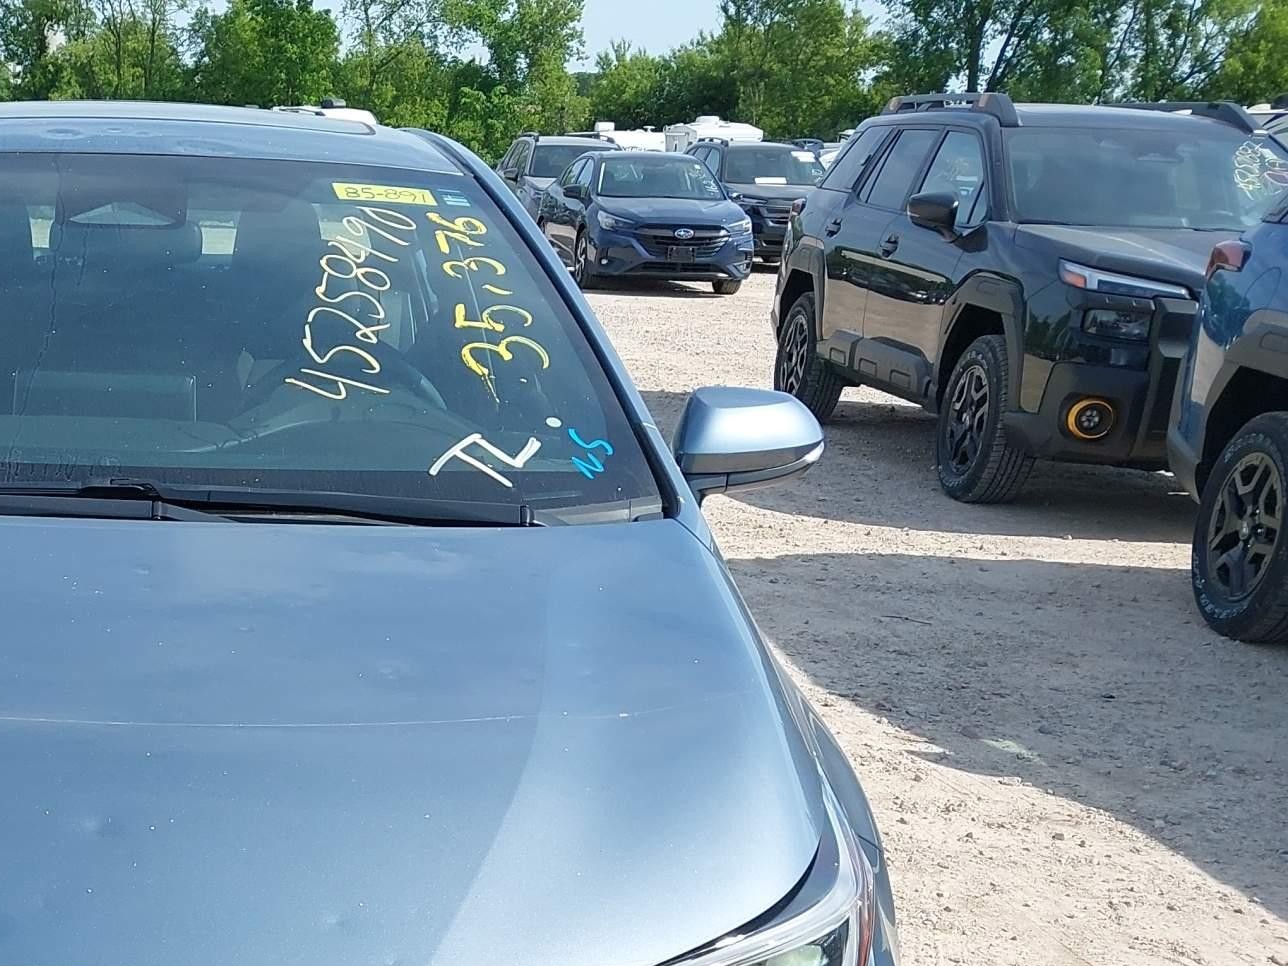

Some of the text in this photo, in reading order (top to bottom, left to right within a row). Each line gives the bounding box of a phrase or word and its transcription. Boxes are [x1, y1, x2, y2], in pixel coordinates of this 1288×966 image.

[285, 205, 417, 400] 45258490
[425, 211, 550, 370] 35,376
[568, 428, 614, 480] NS
